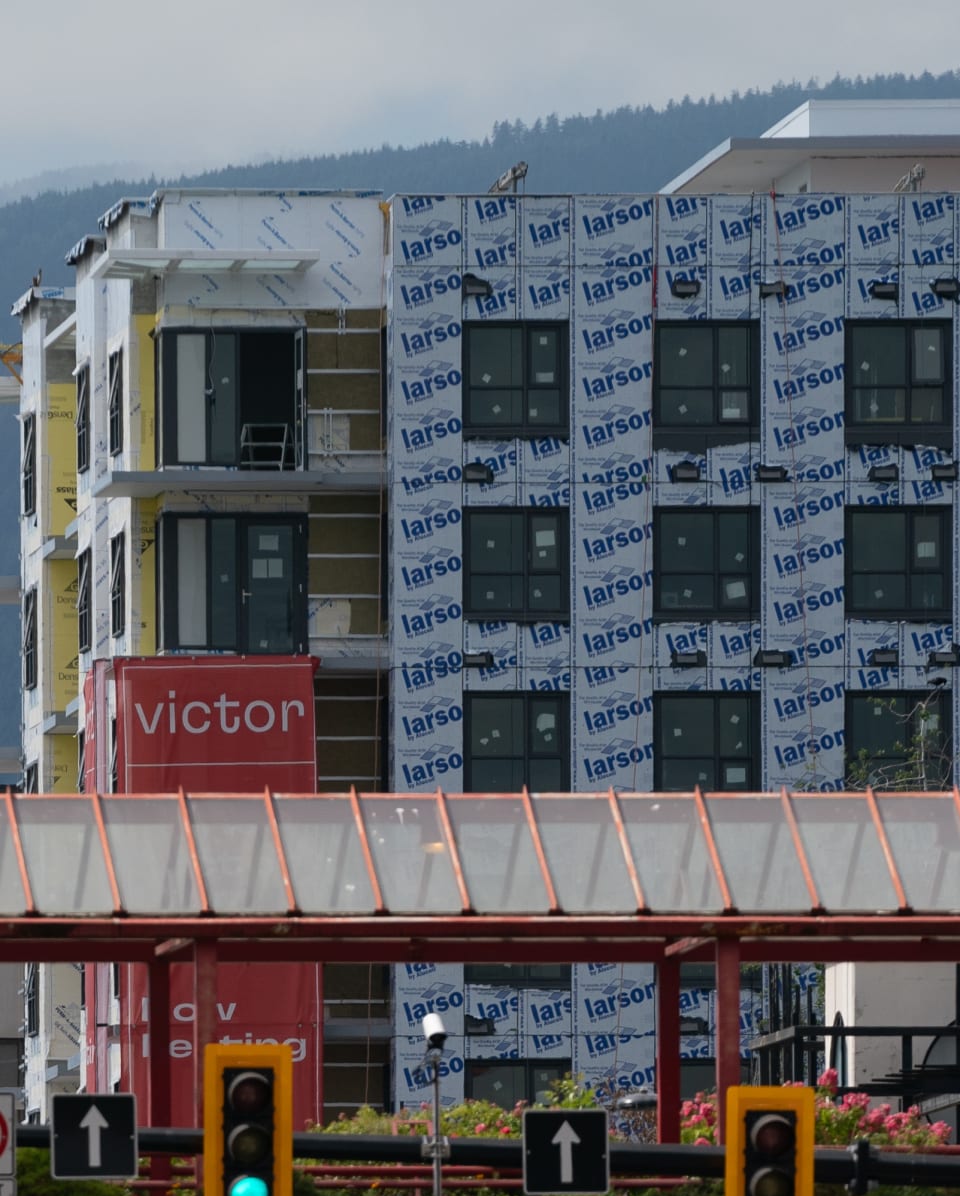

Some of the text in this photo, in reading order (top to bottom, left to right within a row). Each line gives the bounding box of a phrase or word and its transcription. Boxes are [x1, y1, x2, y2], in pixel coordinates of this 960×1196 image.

[400, 229, 462, 261] larso
[400, 274, 462, 306] larso
[784, 267, 845, 303] arson
[400, 322, 462, 354] larso
[773, 316, 845, 352] larson
[400, 370, 462, 402] larso
[773, 364, 845, 400] larson
[400, 417, 462, 449] larso
[773, 412, 845, 448] larson
[400, 508, 462, 540] larso
[773, 491, 845, 527] larson
[400, 556, 462, 588] larso
[773, 539, 845, 575] larson
[400, 603, 462, 635] larso
[773, 586, 845, 622] larson
[135, 690, 304, 734] victor
[773, 683, 845, 719] larson
[402, 705, 463, 737] larso
[773, 730, 845, 766] larson
[402, 753, 463, 785] larso
[403, 991, 464, 1023] larso
